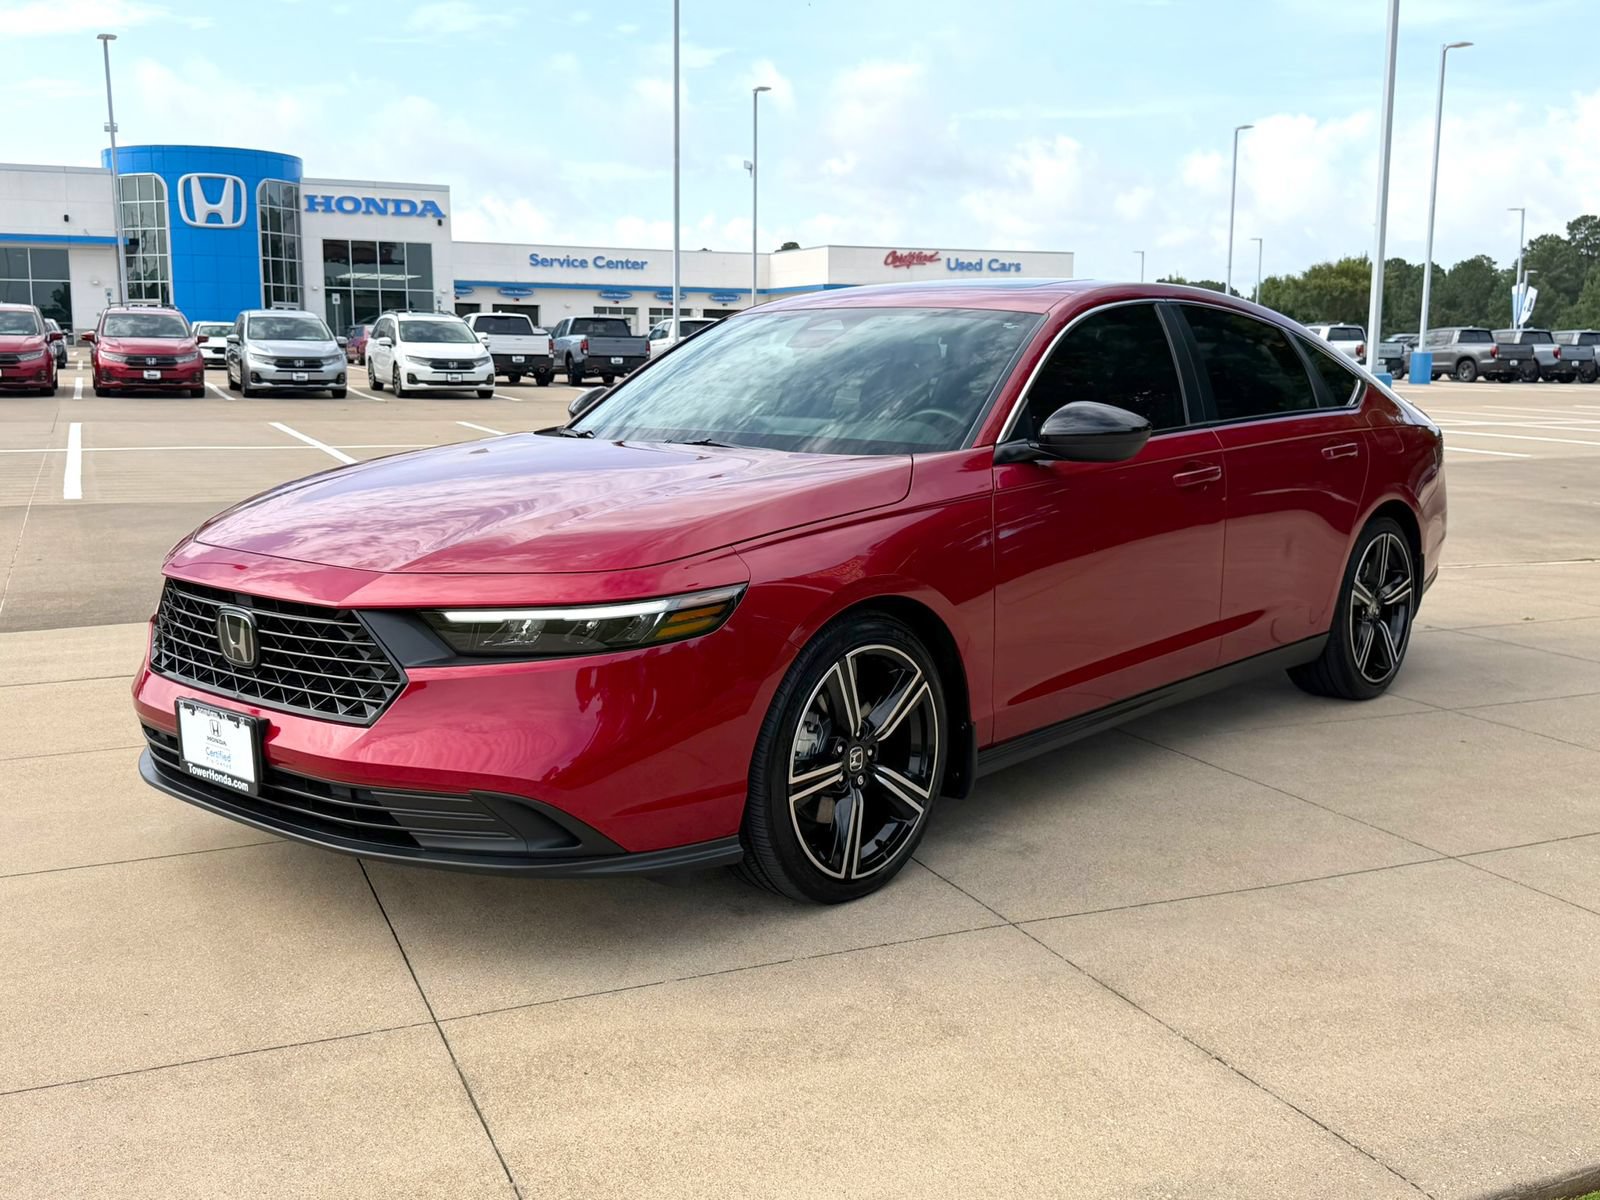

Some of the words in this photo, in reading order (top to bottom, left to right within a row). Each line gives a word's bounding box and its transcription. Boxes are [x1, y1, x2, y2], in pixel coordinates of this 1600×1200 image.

[304, 194, 446, 218] HONDA
[529, 253, 589, 269] Service
[593, 255, 648, 271] Center
[946, 257, 983, 271] Used
[987, 258, 1022, 272] Cars
[187, 762, 249, 792] TowerHonda.com
